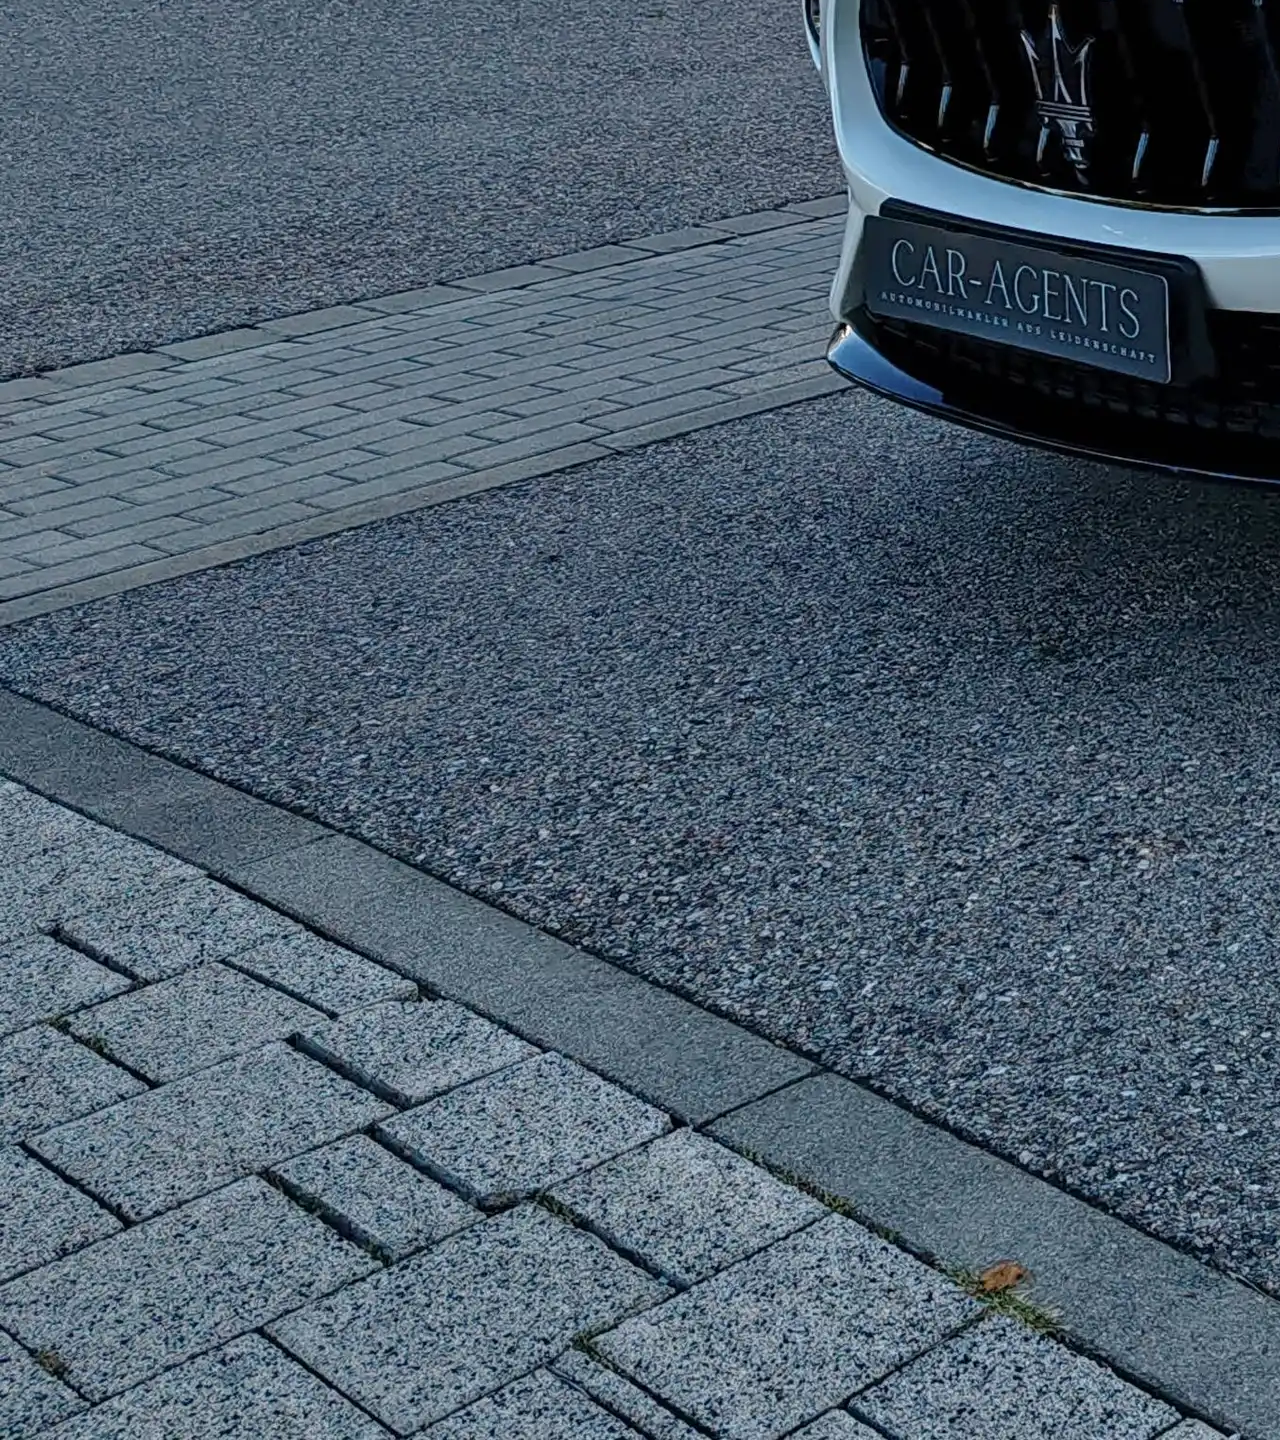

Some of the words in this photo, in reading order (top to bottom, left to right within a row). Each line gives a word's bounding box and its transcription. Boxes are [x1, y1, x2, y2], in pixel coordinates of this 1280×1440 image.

[881, 291, 1009, 328] AUTOMOBILMAKLER
[1016, 322, 1041, 335] AUS
[1050, 329, 1157, 364] LEIDENSCHAFT
[892, 239, 1140, 339] CAR-AGENTS
